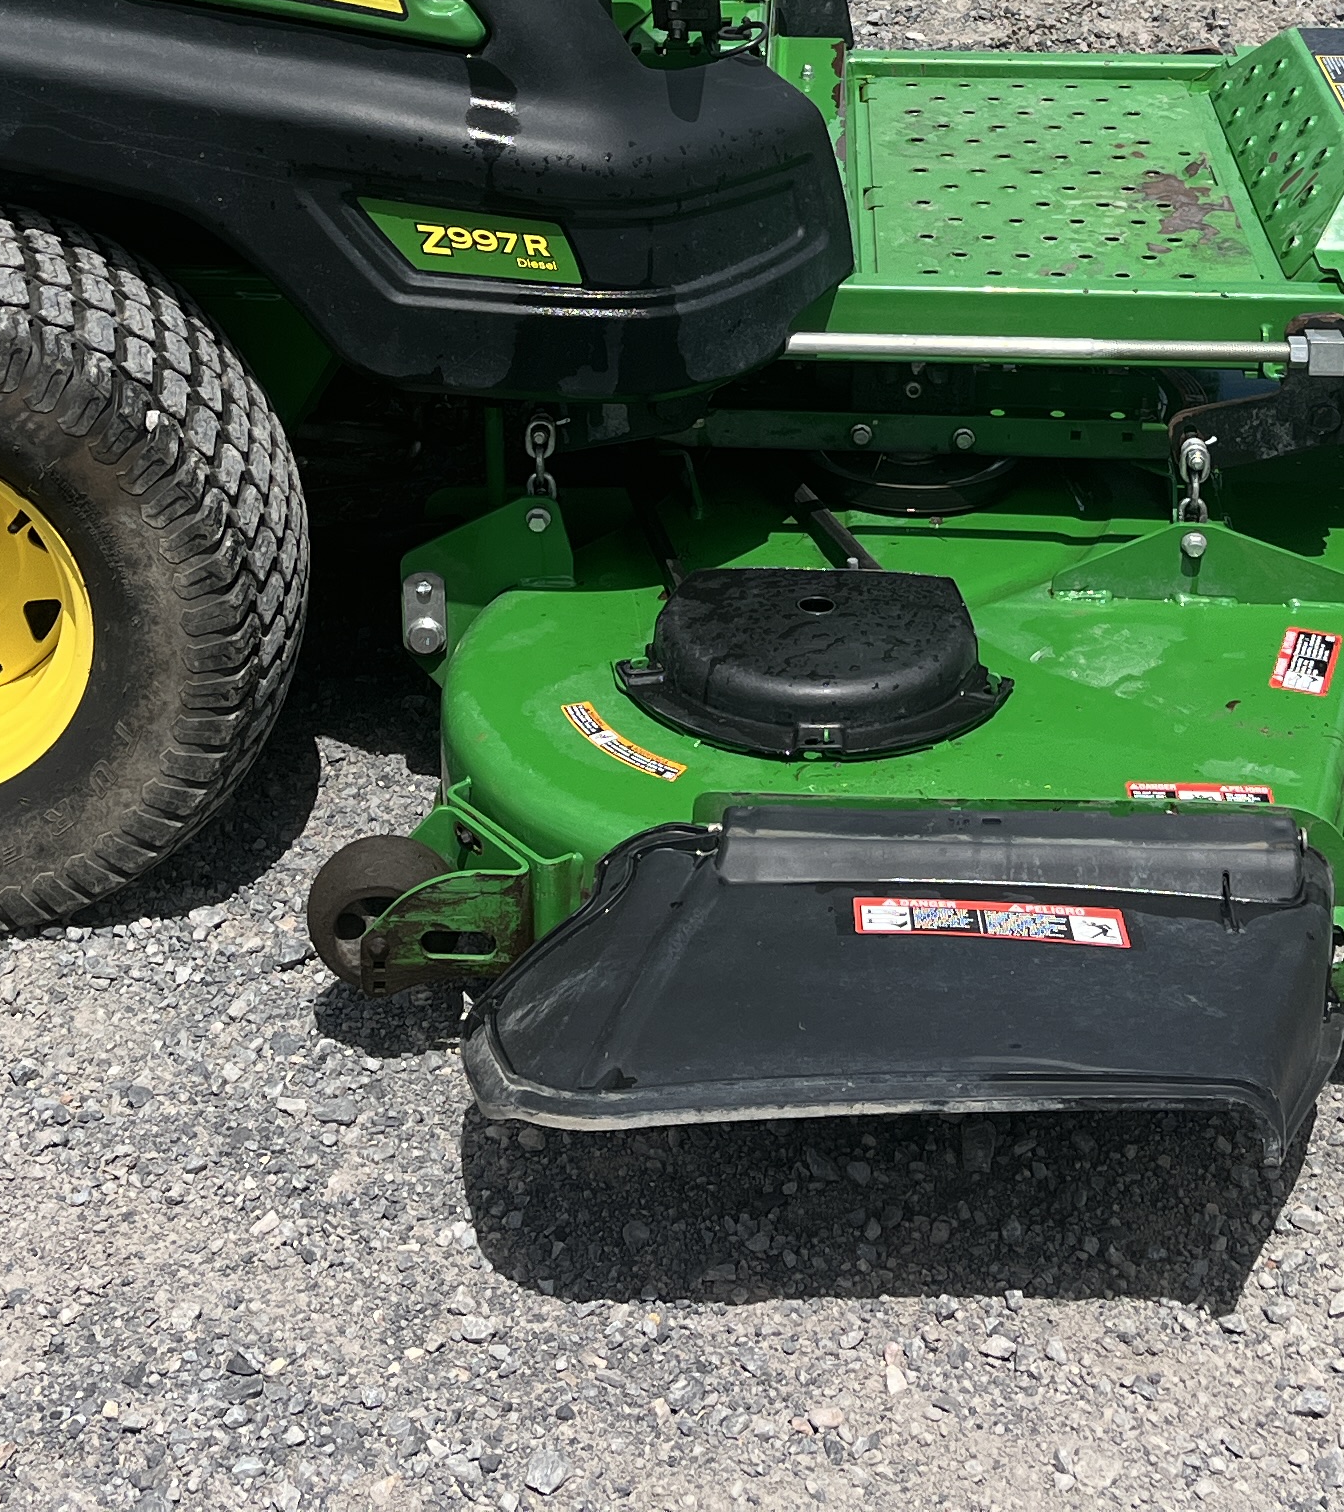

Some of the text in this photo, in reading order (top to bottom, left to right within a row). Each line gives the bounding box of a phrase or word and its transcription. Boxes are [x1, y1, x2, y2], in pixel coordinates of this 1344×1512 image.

[516, 257, 559, 272] Diesel
[899, 898, 957, 909] DANGER
[1025, 904, 1086, 916] PELIGRO
